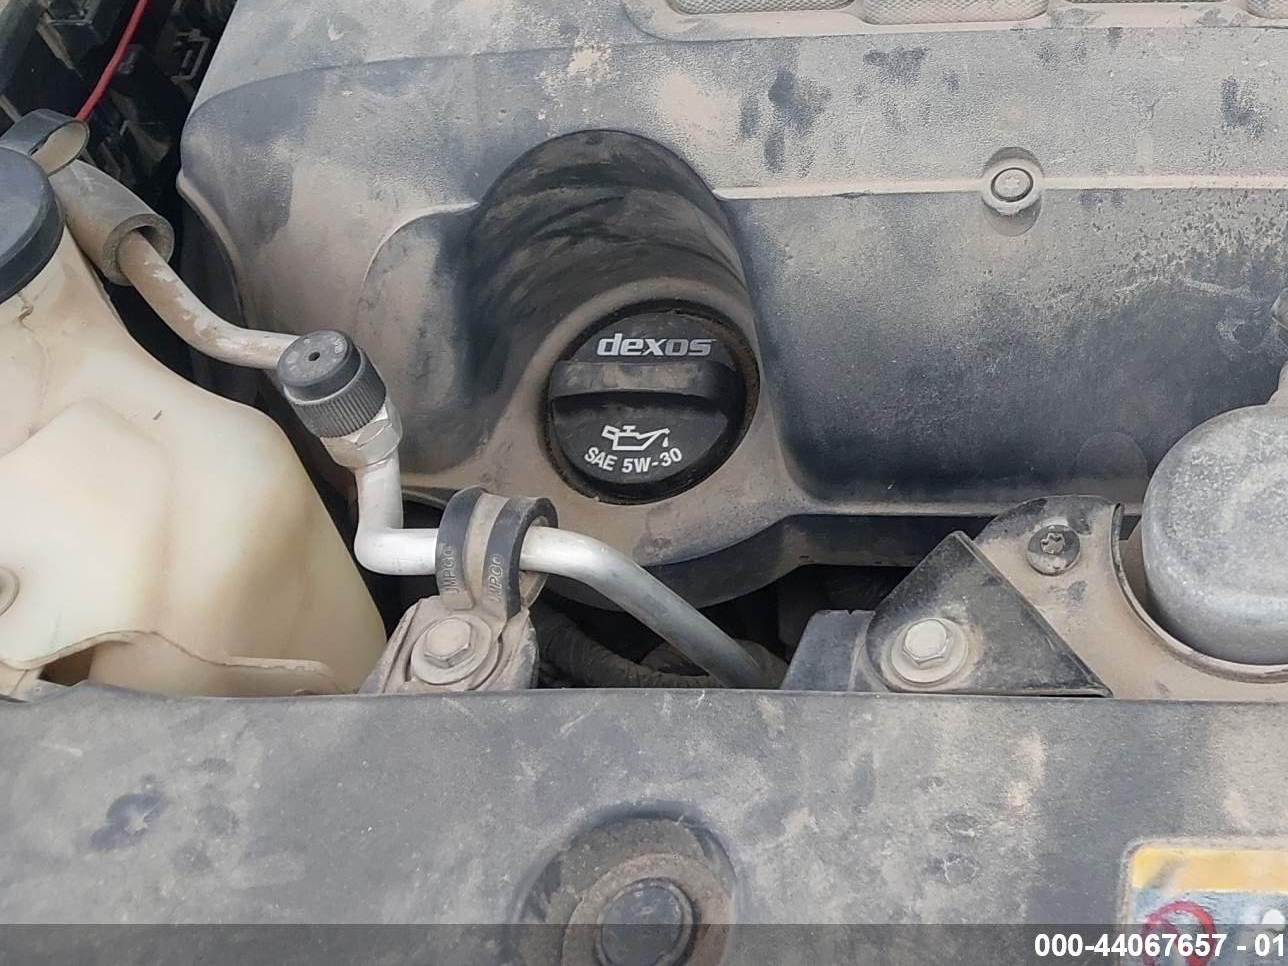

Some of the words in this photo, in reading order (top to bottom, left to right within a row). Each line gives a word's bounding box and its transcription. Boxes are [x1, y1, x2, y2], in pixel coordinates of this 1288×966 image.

[596, 333, 717, 356] dexos
[583, 446, 617, 470] SAE
[621, 447, 683, 473] 5W-30
